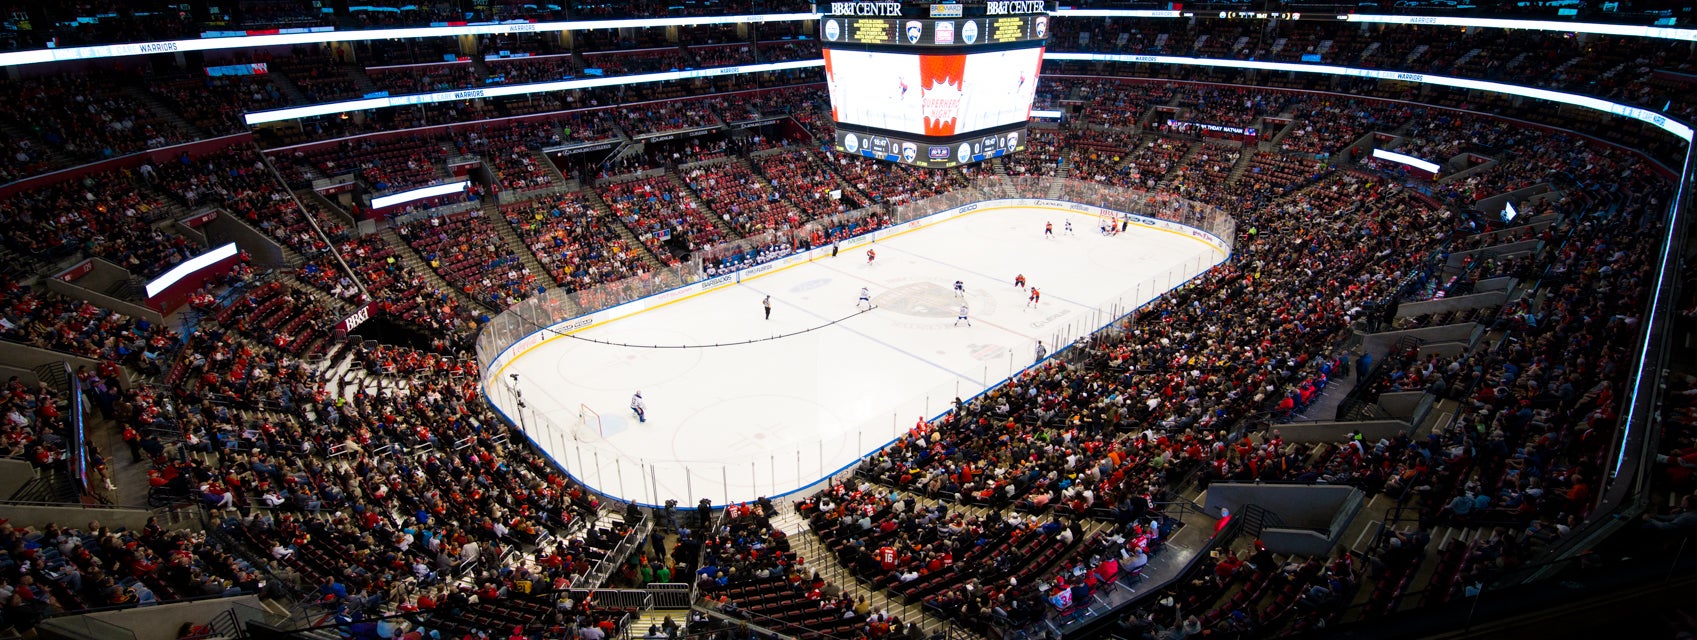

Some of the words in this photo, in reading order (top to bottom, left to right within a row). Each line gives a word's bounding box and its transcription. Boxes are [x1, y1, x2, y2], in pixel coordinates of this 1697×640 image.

[831, 2, 856, 16] BB&T
[856, 2, 902, 16] CENTER
[986, 1, 1009, 15] BB&T
[1009, 0, 1045, 14] CENTER
[139, 42, 178, 53] WARRIORS
[454, 89, 485, 99] WARRIORS
[931, 109, 951, 118] NIGHT
[1223, 126, 1243, 134] NATHAN
[862, 138, 868, 149] 0
[1000, 137, 1005, 148] 0
[892, 143, 899, 154] 0
[974, 143, 980, 154] 0
[959, 204, 977, 213] GEICO
[83, 262, 92, 272] 129
[701, 275, 732, 288] BARBADOS
[345, 305, 369, 332] BB&T
[884, 553, 893, 563] 16
